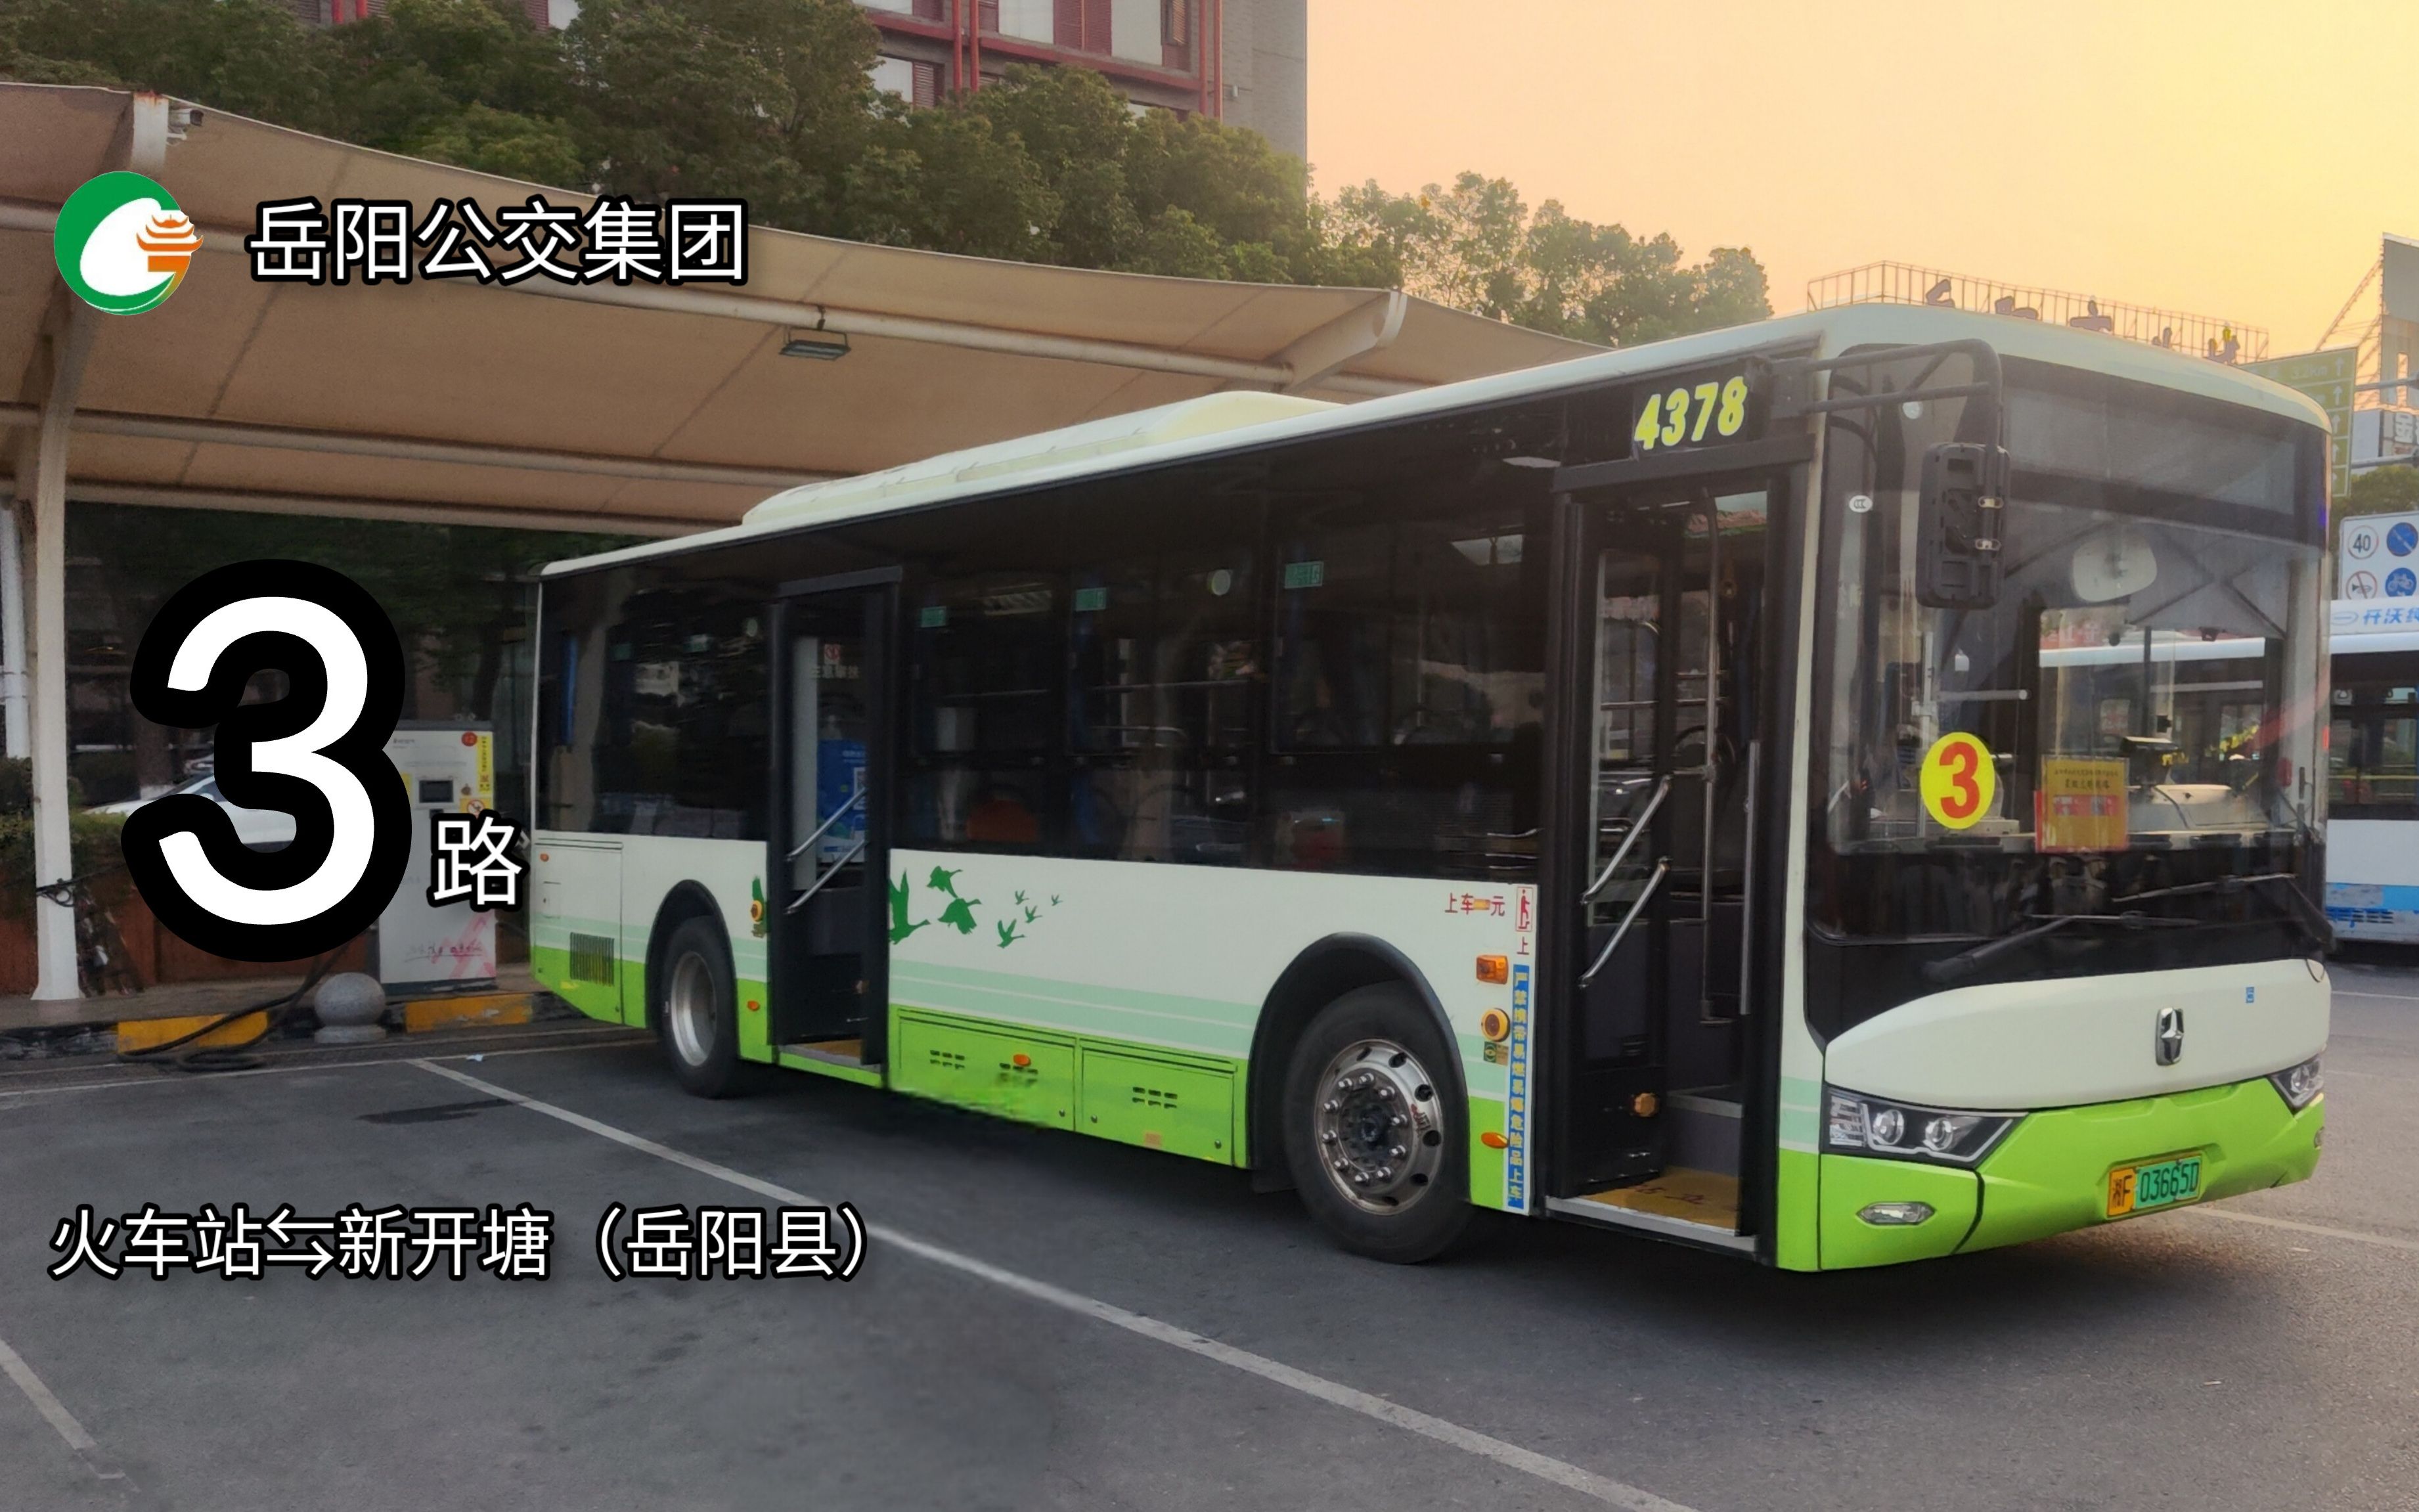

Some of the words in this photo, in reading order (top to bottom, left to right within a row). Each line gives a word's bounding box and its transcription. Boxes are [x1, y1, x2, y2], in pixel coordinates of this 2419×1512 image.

[1634, 376, 1748, 451] 4378
[2353, 533, 2372, 554] 40
[1939, 741, 1981, 820] 3
[1516, 936, 1530, 955] 上
